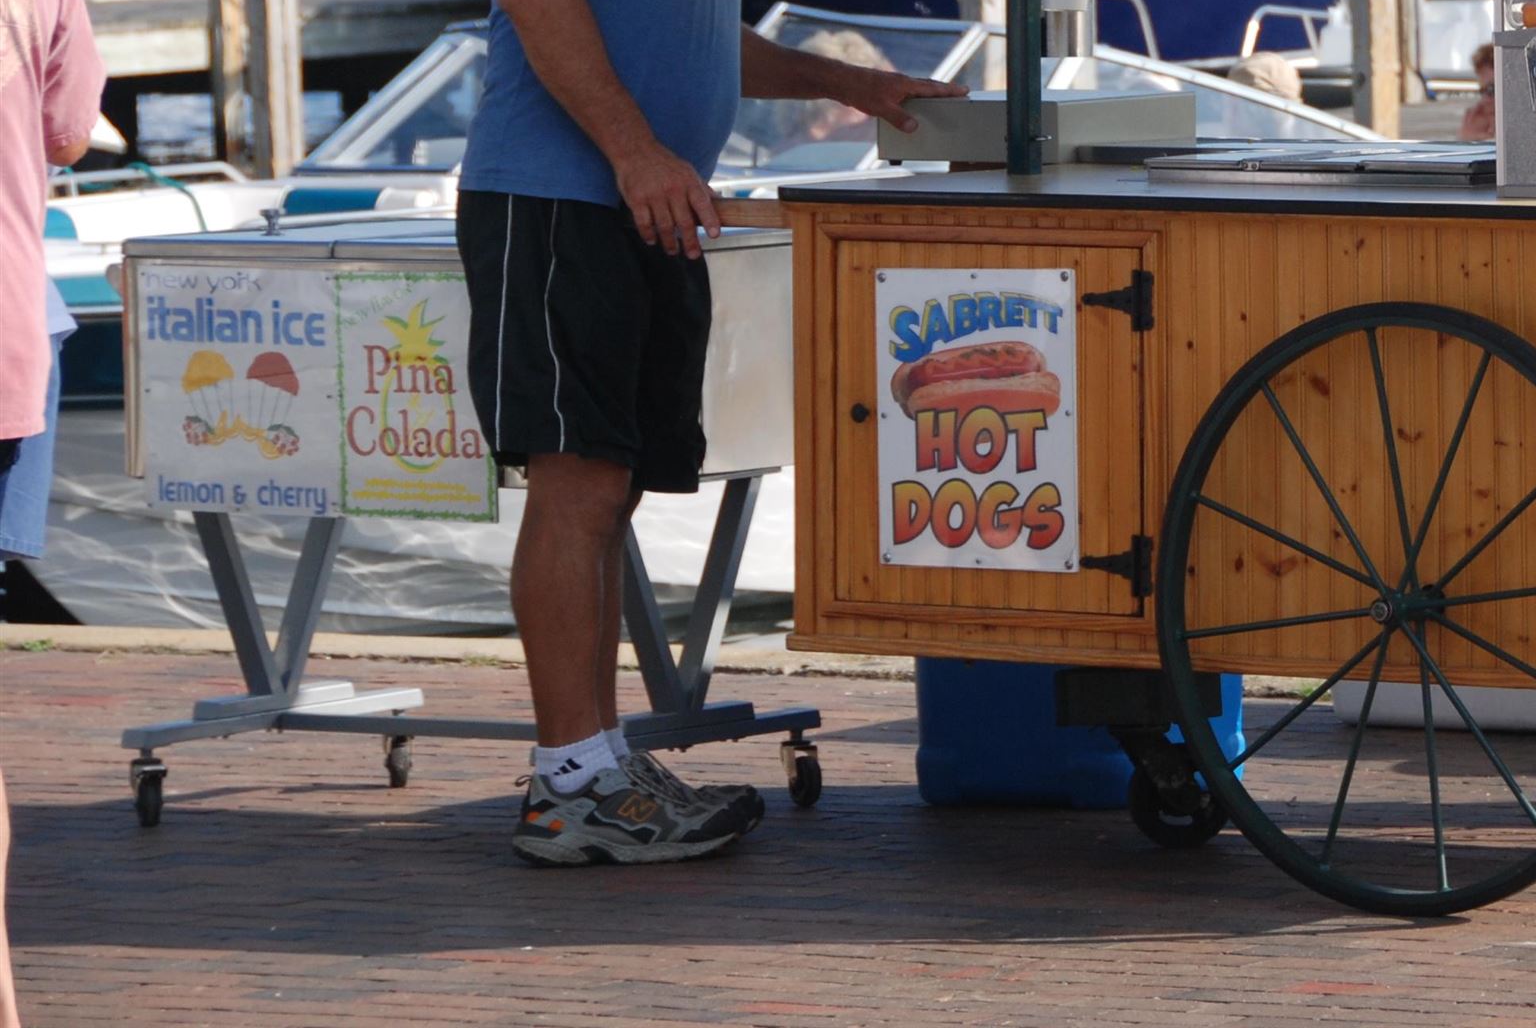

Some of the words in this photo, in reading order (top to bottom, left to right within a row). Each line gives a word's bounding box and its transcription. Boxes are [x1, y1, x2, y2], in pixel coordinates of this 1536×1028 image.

[144, 273, 198, 291] new
[206, 273, 263, 295] york
[147, 296, 264, 344] italian
[273, 300, 327, 347] ice
[888, 290, 1064, 363] SABRETT
[363, 345, 457, 394] Piña
[346, 406, 485, 459] Colada
[915, 405, 1048, 474] HOT
[158, 475, 225, 505] lemon
[233, 483, 246, 504] &
[257, 479, 328, 515] cherry
[891, 478, 1065, 550] DOGS
